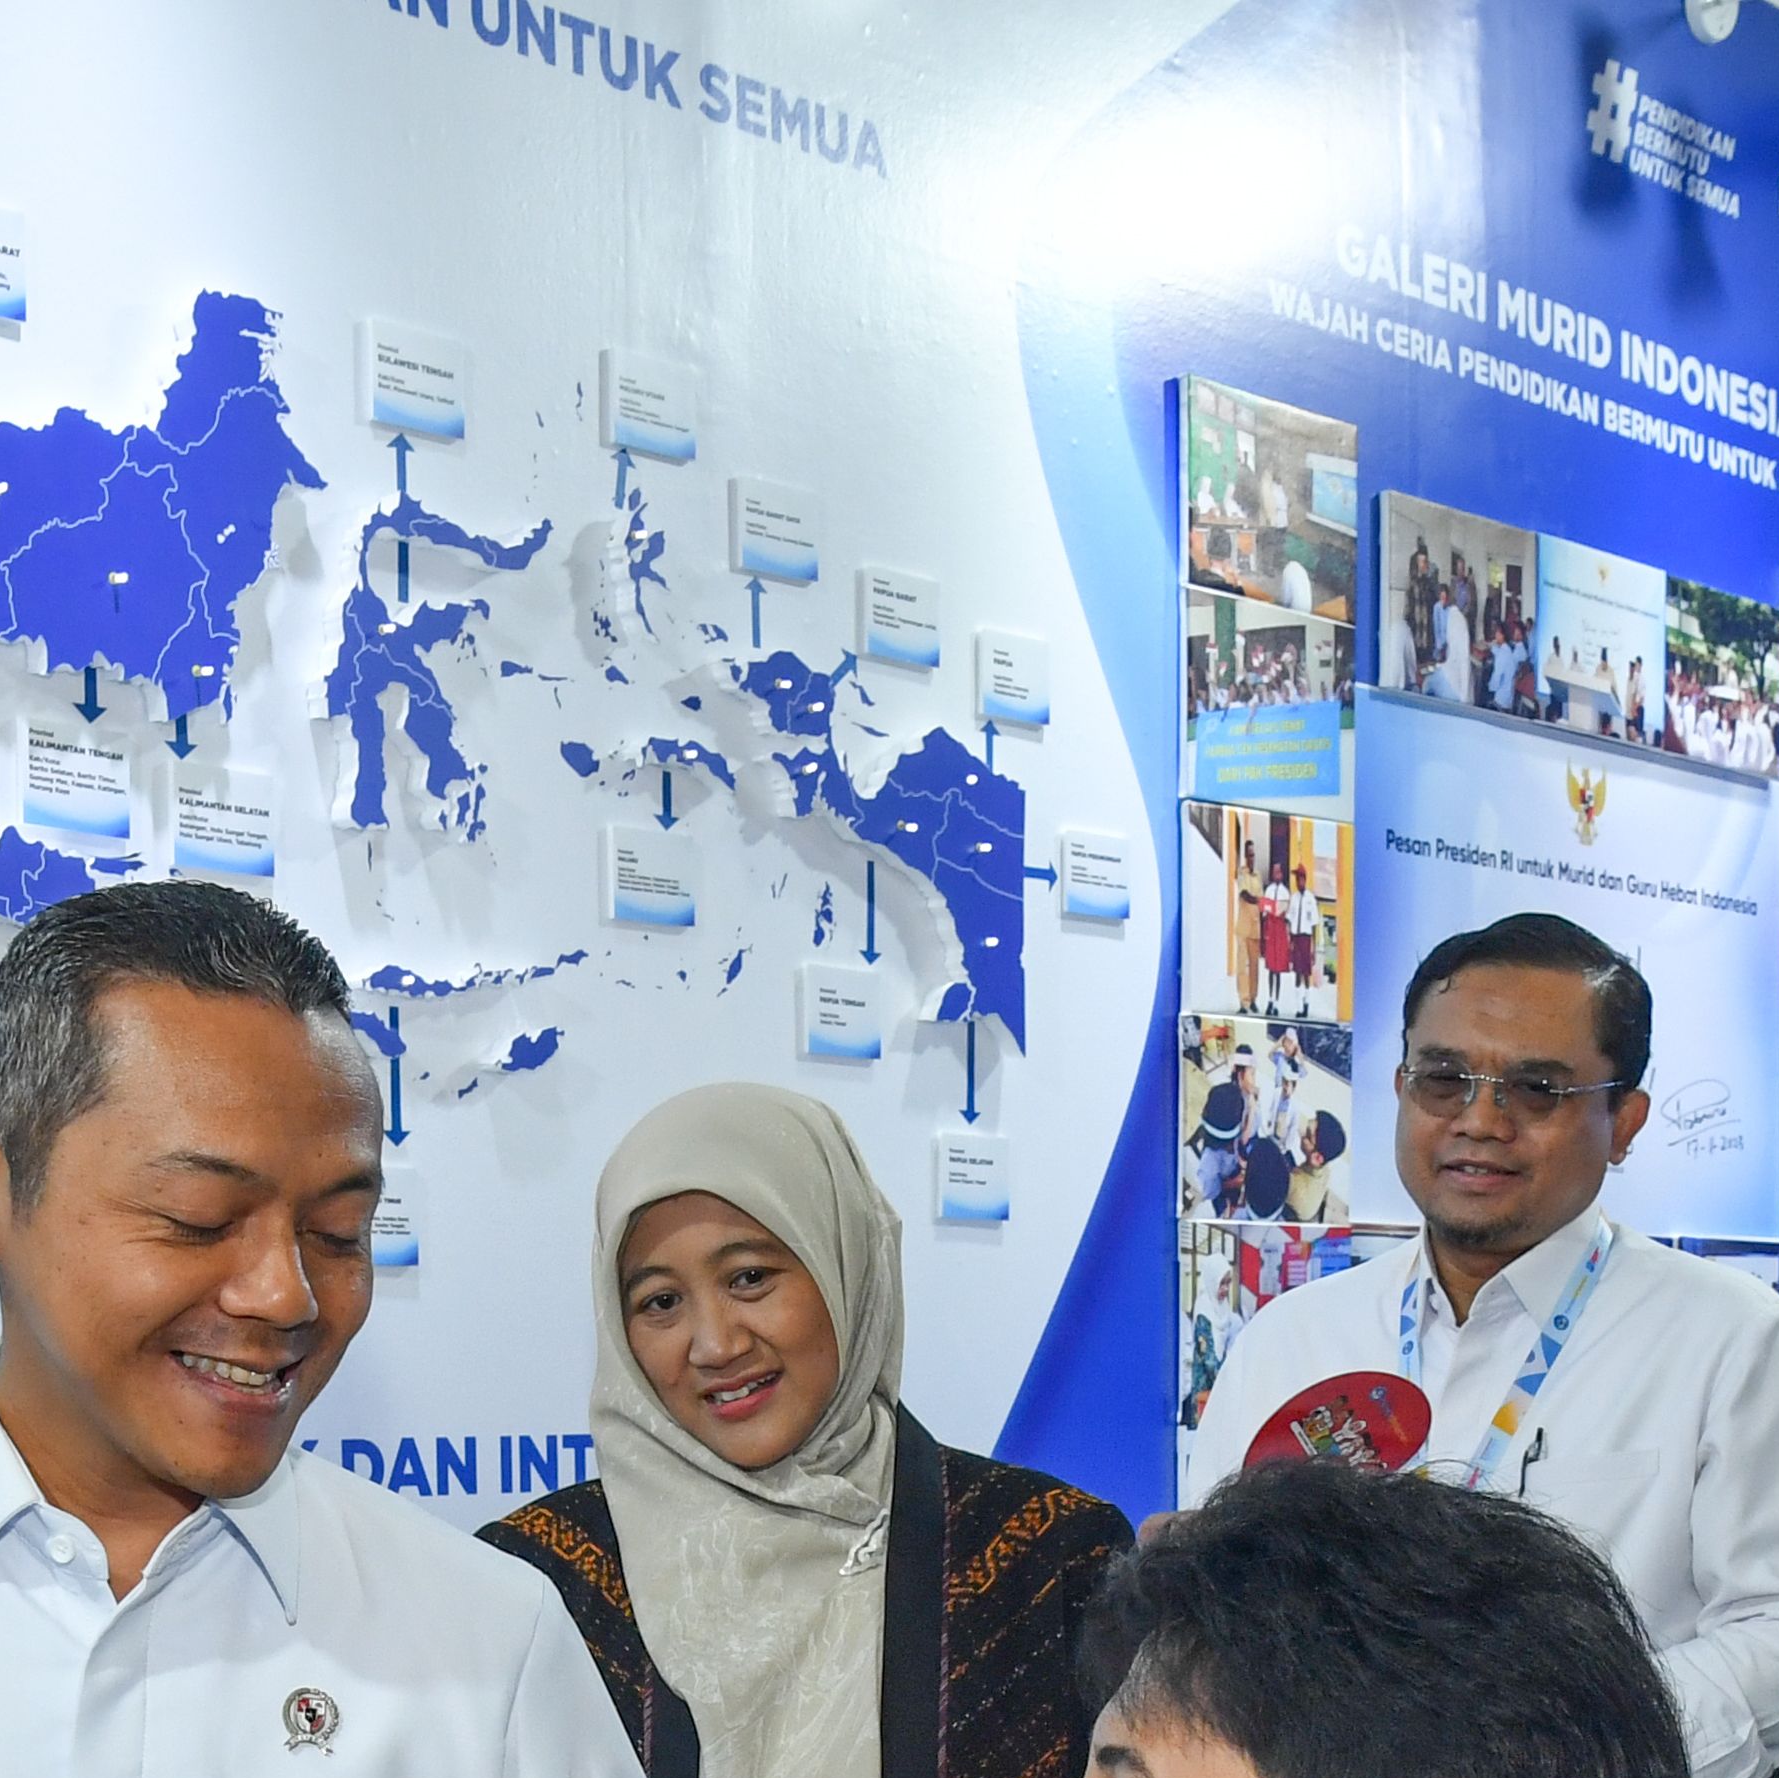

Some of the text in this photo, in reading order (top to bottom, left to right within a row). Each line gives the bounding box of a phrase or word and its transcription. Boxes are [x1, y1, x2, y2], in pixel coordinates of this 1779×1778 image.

[470, 0, 889, 181] UNTUK SEMUA
[1634, 120, 1711, 176] BERMUTU
[1638, 94, 1736, 161] PENDIDIKAN
[1630, 147, 1683, 192] UNTUK
[1686, 174, 1741, 219] SEMUA
[1337, 223, 1488, 324] GALERI
[1497, 281, 1612, 369] MURID
[1268, 280, 1369, 346] WAJAH
[1376, 319, 1452, 378] CERIA
[1458, 346, 1599, 427] PENDIDIKAN
[1603, 400, 1704, 464] BERMUTU
[1708, 438, 1776, 490] UNTUK
[29, 738, 123, 761] KALIMANTAN TENGAH
[179, 797, 269, 817] KALIMANTAN SELATAN
[1386, 829, 1758, 917] Pesan Presiden RI untuk Murid dan Guru Hebat Indonesia
[341, 1437, 477, 1497] DAN
